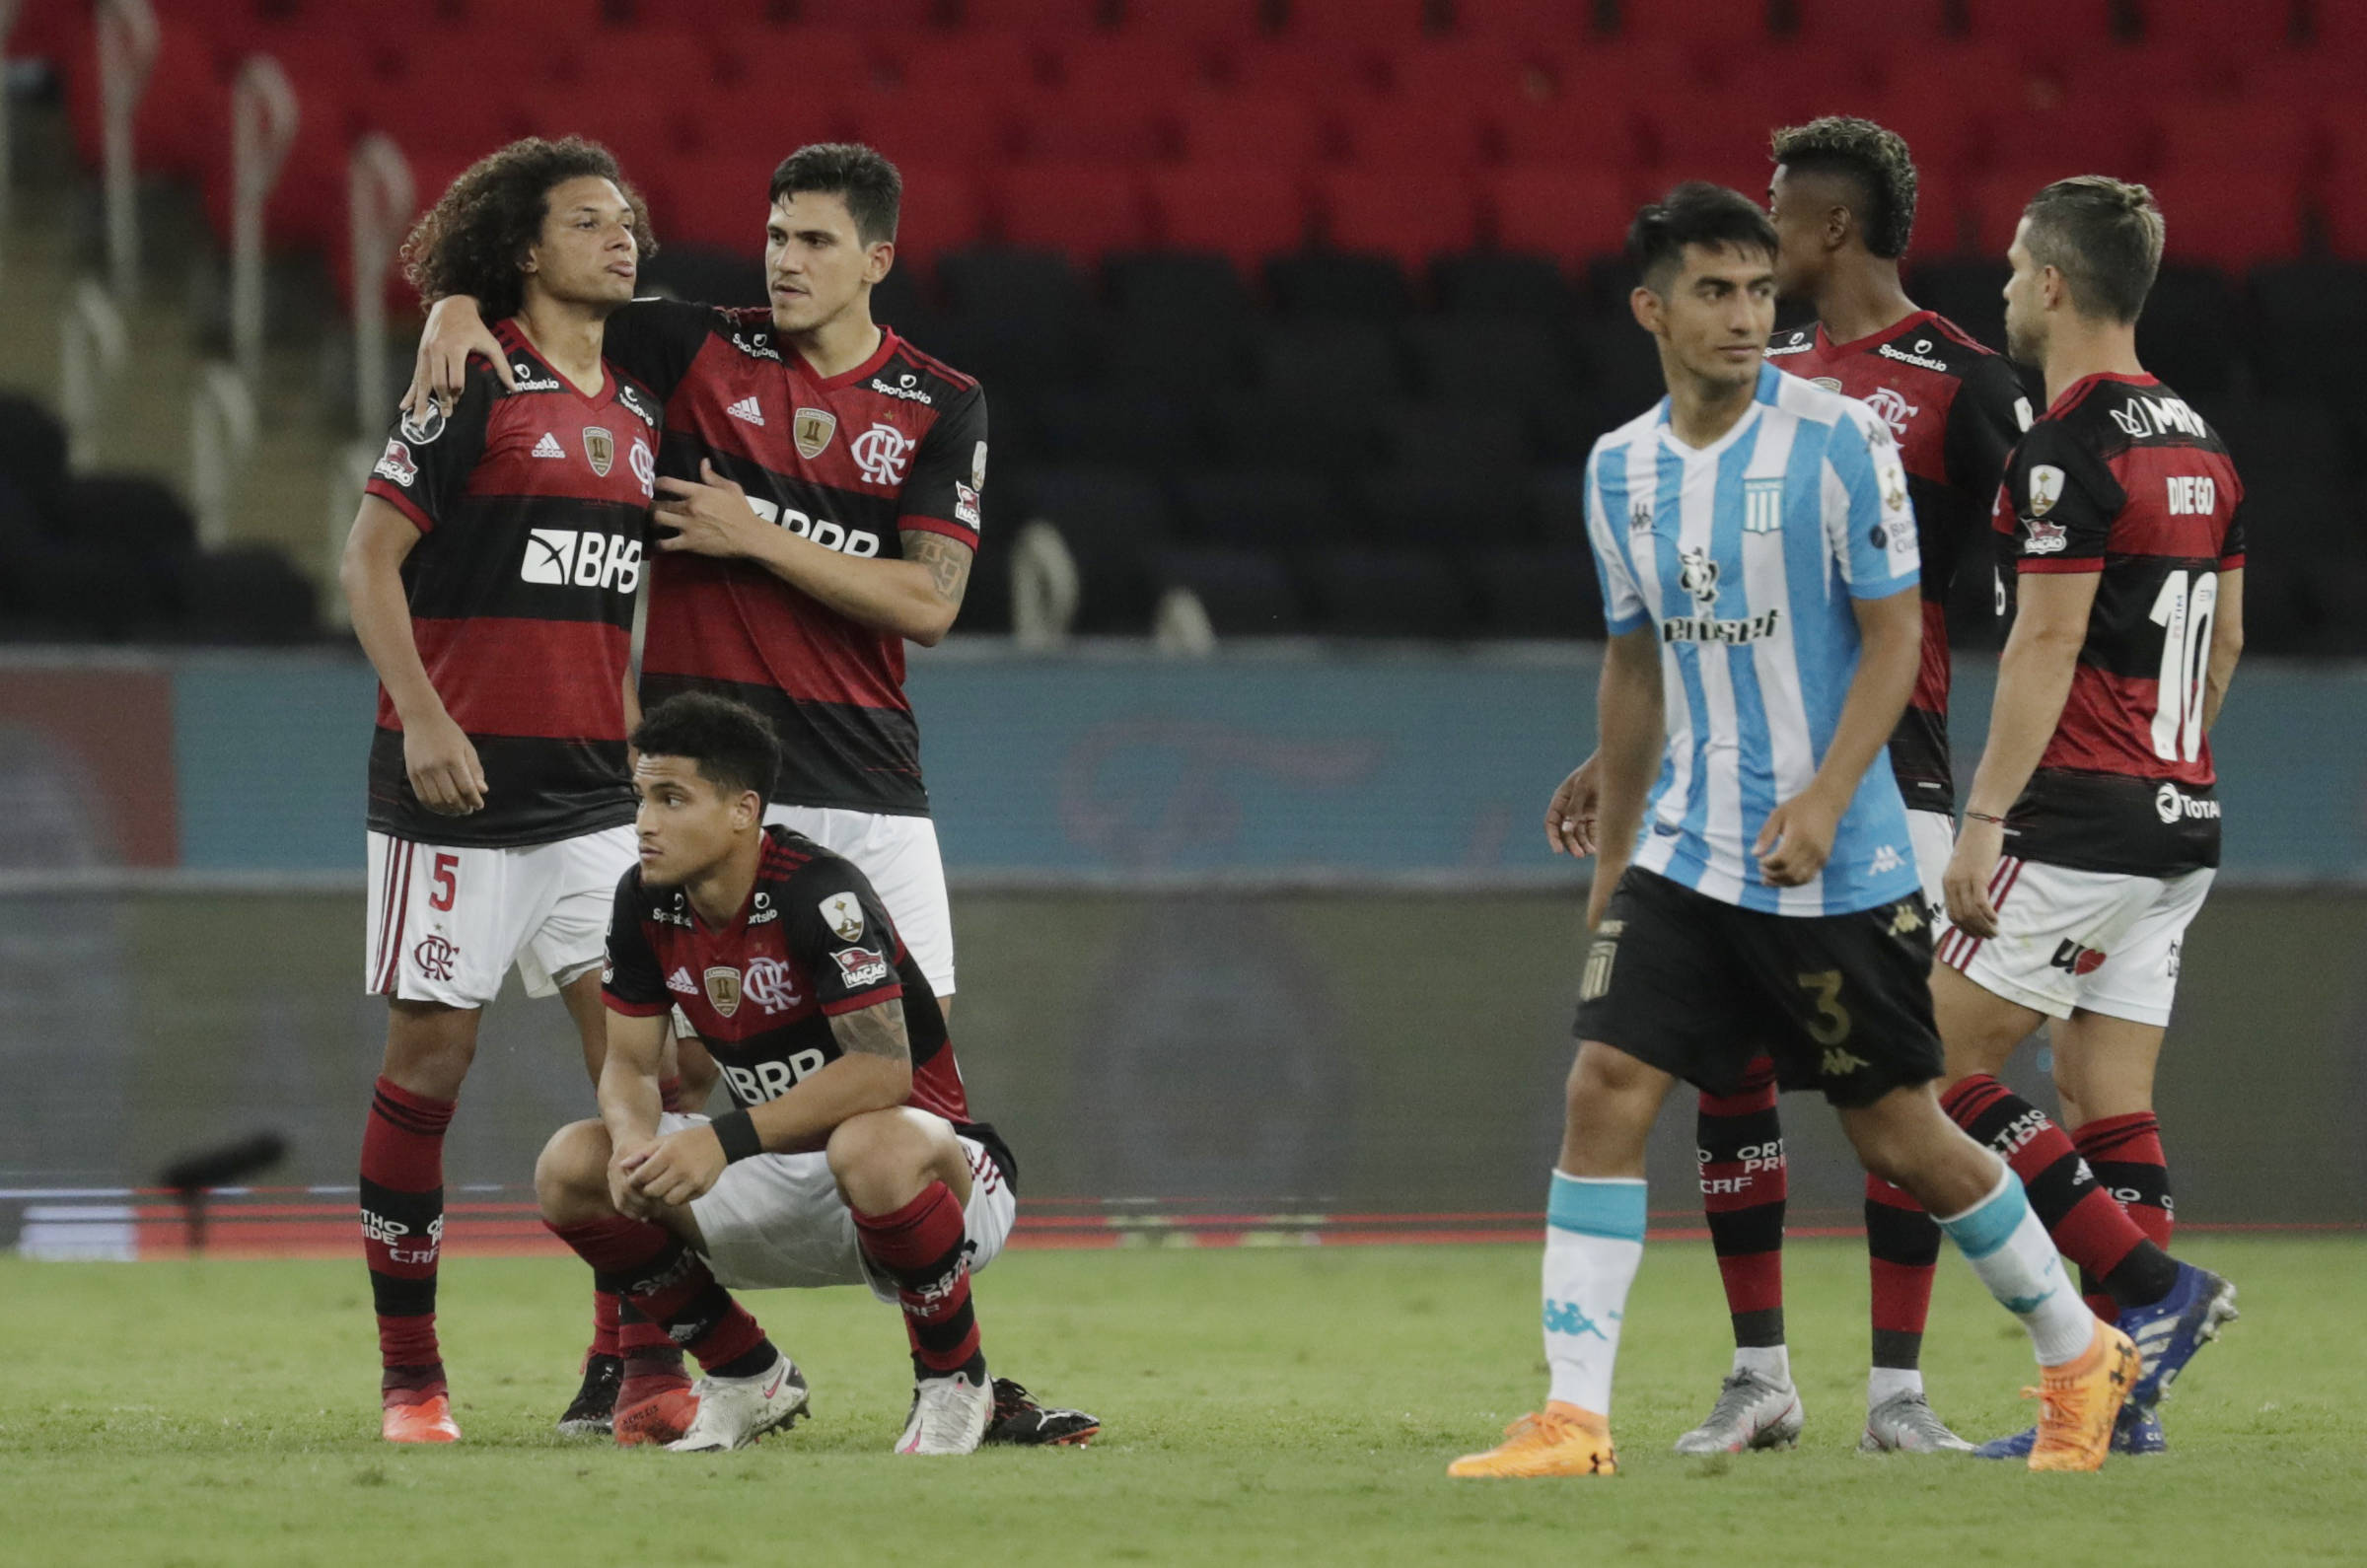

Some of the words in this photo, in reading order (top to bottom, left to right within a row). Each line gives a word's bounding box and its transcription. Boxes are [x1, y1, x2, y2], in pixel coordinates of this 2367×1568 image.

[1879, 344, 1947, 373] Sportsbet.io
[727, 406, 765, 426] adidas
[532, 449, 566, 459] adidas
[2167, 476, 2215, 516] DIEGO
[2149, 570, 2218, 763] 10
[428, 852, 460, 912] 5
[845, 962, 886, 985] NAÇÃO
[1797, 969, 1852, 1046] 3
[1700, 1176, 1753, 1194] CRF
[390, 1246, 439, 1264] CRF
